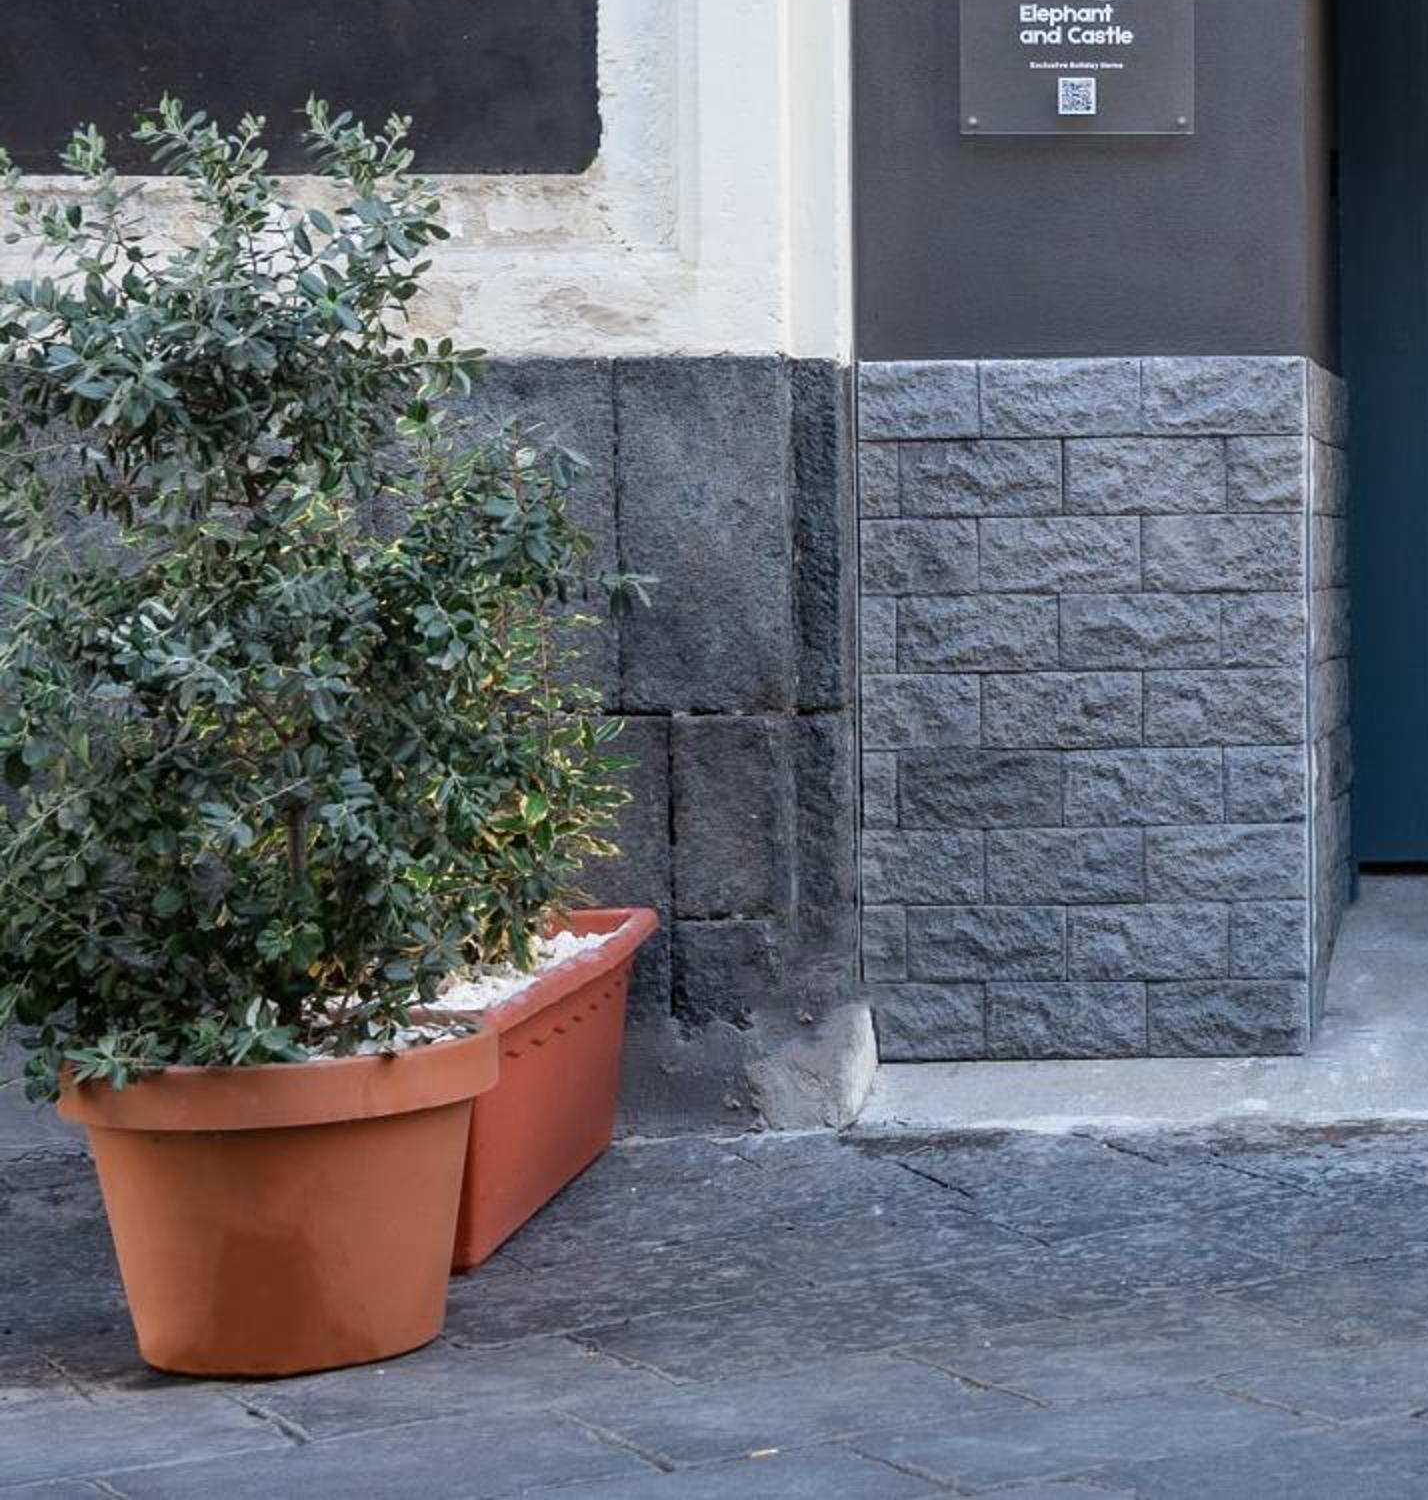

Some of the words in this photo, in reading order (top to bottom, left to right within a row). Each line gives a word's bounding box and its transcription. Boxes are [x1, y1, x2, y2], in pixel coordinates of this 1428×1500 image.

[1020, 4, 1113, 26] Elephant
[1020, 26, 1062, 44] and
[1068, 26, 1134, 44] Castle
